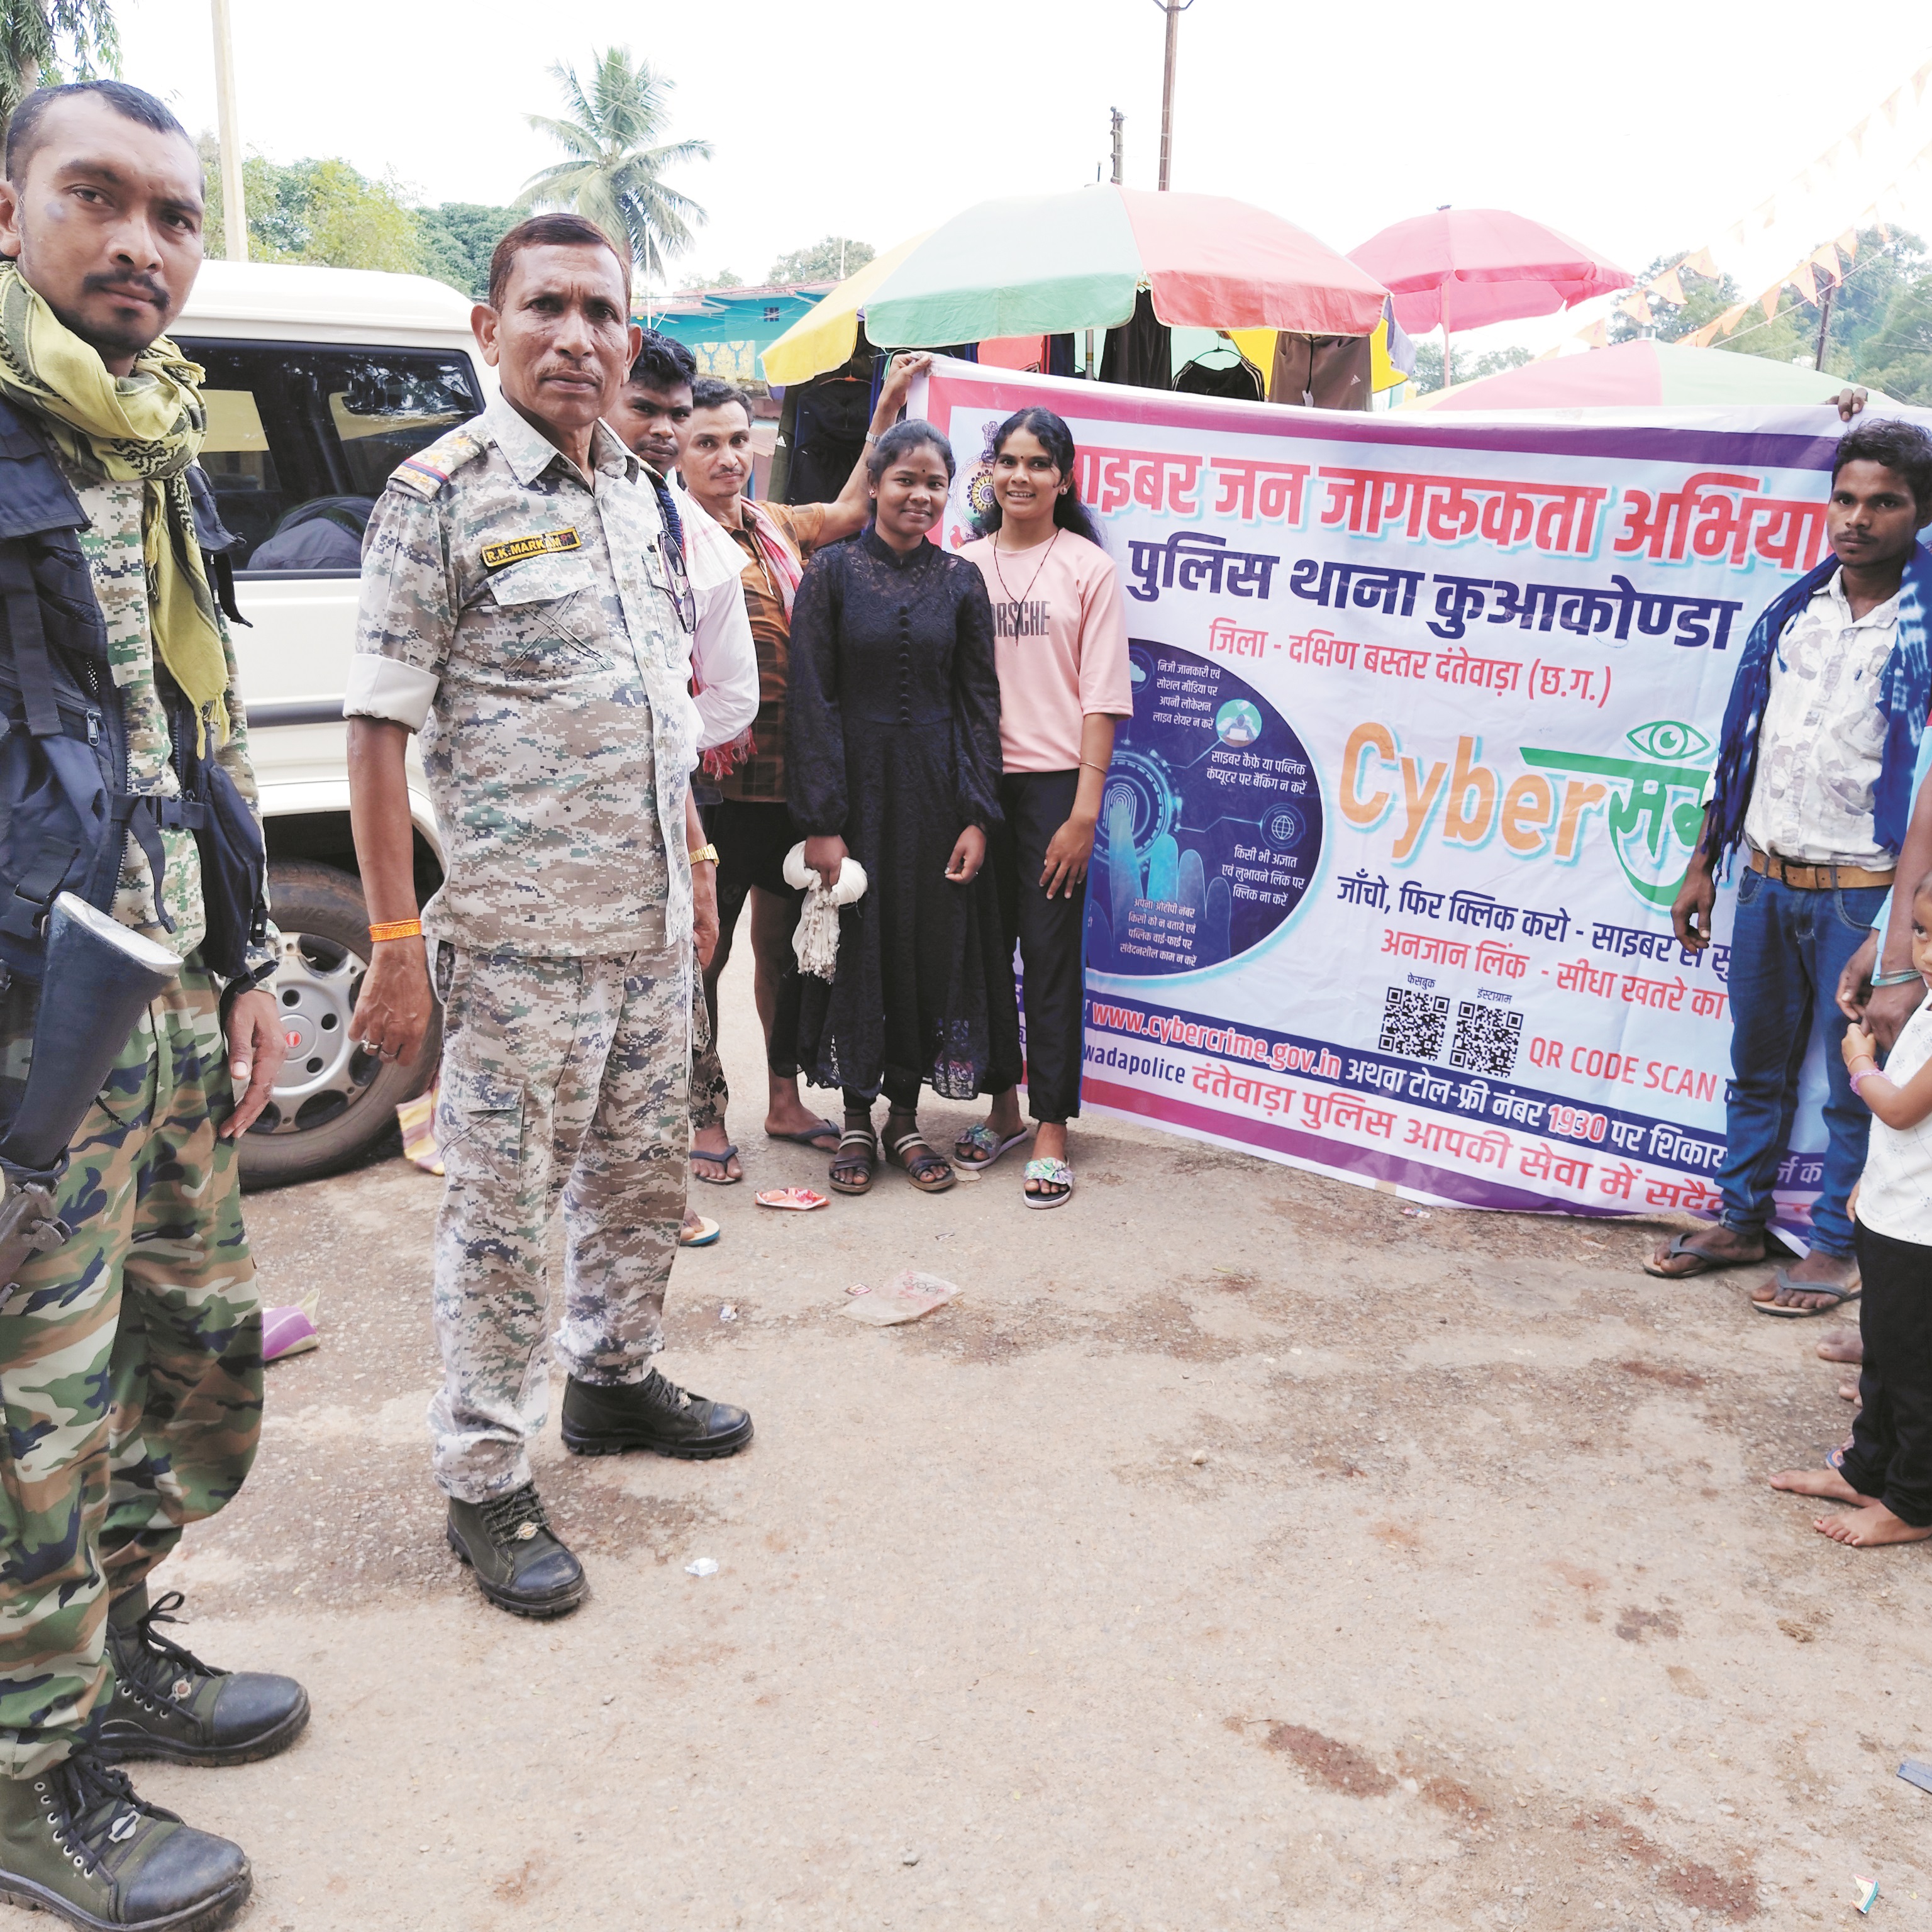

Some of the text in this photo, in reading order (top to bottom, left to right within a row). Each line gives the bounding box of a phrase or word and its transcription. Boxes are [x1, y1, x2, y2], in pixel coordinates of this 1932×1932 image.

[1074, 444, 1835, 571] ाइबर जन जागरूकता अभिया
[1126, 531, 1743, 650] पुलिस थाना कुआकोण्डा
[1157, 659, 1221, 679] निजी जानकारी एवं
[1209, 617, 1269, 658] जिला
[1289, 629, 1360, 670] दक्षिण
[1364, 645, 1431, 680] बस्तर
[1436, 647, 1523, 697] दंतेवाड़ा
[1528, 658, 1612, 708] (छ.ग.)
[1157, 677, 1218, 696] सोशल मीडिया पर
[1159, 695, 1212, 712] अपनी लोकेशन
[1153, 711, 1214, 730] लाइव शेयर न करें
[1211, 750, 1241, 766] साइबर
[1262, 758, 1274, 771] या
[1275, 758, 1307, 775] पब्लिक
[1206, 765, 1308, 795] कंप्यूटर पर बैंकिंग न करें
[1339, 722, 1607, 859] Cyber
[1234, 844, 1298, 868] किसी भी अज्ञात
[1222, 863, 1306, 889] एवं लुभावने लिंक पर
[1134, 898, 1153, 910] अपना
[1155, 900, 1178, 915] ओटीपी
[1233, 883, 1289, 906] क्लिक ना करें
[1128, 911, 1146, 924] किसी
[1148, 915, 1158, 926] को
[1158, 918, 1165, 928] न
[1185, 923, 1196, 935] एवं
[1337, 869, 1392, 914] जाँचो,
[1398, 880, 1446, 919] फिर
[1448, 890, 1519, 931] क्लिक
[1521, 908, 1572, 943] करो
[1591, 922, 1676, 962] साइबर
[1128, 927, 1152, 941] पब्लिक
[1182, 938, 1193, 950] पर
[1120, 942, 1197, 967] संवेदनशील काम न करें
[1381, 929, 1473, 965] अनजान
[1474, 940, 1531, 980] लिंक
[1556, 959, 1617, 999] सीधा
[1621, 975, 1688, 1012] खतरे
[1690, 988, 1729, 1020] का
[1407, 972, 1436, 990] फेसबुक
[1477, 987, 1513, 1004] इंस्टाग्राम
[1528, 1036, 1564, 1070] QR
[1571, 1046, 1640, 1084] CODE
[1643, 1061, 1718, 1103] SCAN
[1092, 1002, 1342, 1080] www.cybercrime.gov.in
[1345, 1059, 1407, 1095] अथवा
[1408, 1067, 1491, 1114] टोल-फ्री
[1492, 1090, 1546, 1127] नंबर
[1548, 1104, 1607, 1143] 1930
[1610, 1120, 1646, 1152] पर
[1648, 1123, 1728, 1169] शिकाय
[1084, 1045, 1186, 1084] wadapolice
[1192, 1062, 1297, 1116] दंतेवाड़ा
[1301, 1092, 1397, 1139] पुलिस
[1403, 1118, 1515, 1170] आपकी
[1519, 1143, 1594, 1191] सेवा
[1599, 1163, 1643, 1200] में
